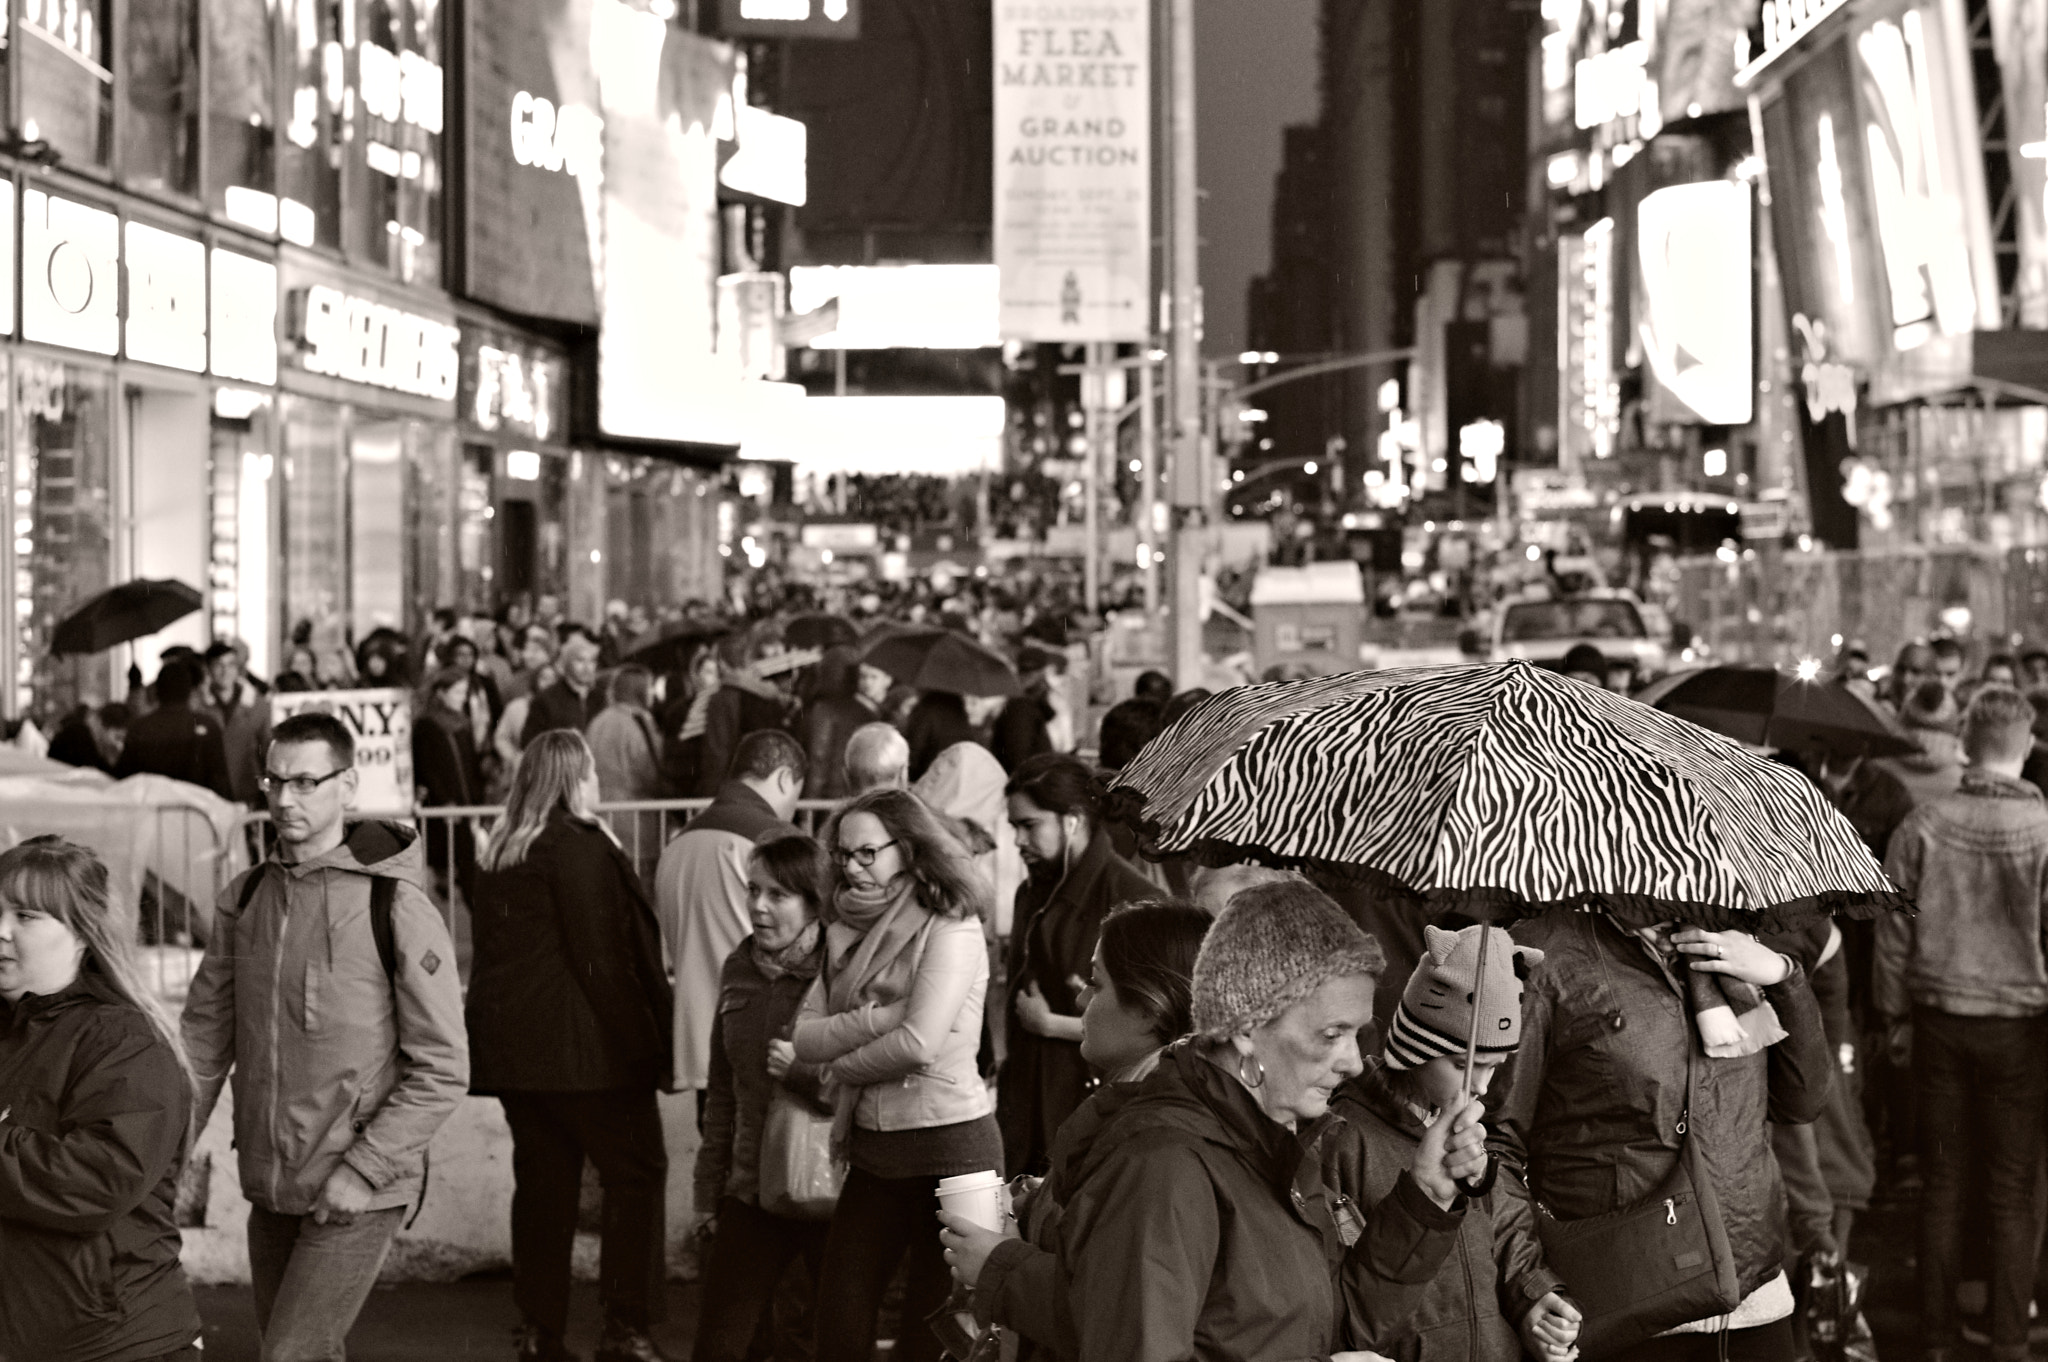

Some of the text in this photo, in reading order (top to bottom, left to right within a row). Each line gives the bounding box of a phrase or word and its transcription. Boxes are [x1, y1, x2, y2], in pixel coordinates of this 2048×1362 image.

[1018, 28, 1122, 57] FLEA
[1002, 63, 1139, 88] MARKET
[1020, 117, 1126, 138] GRAND
[1009, 146, 1139, 167] AUCTION
